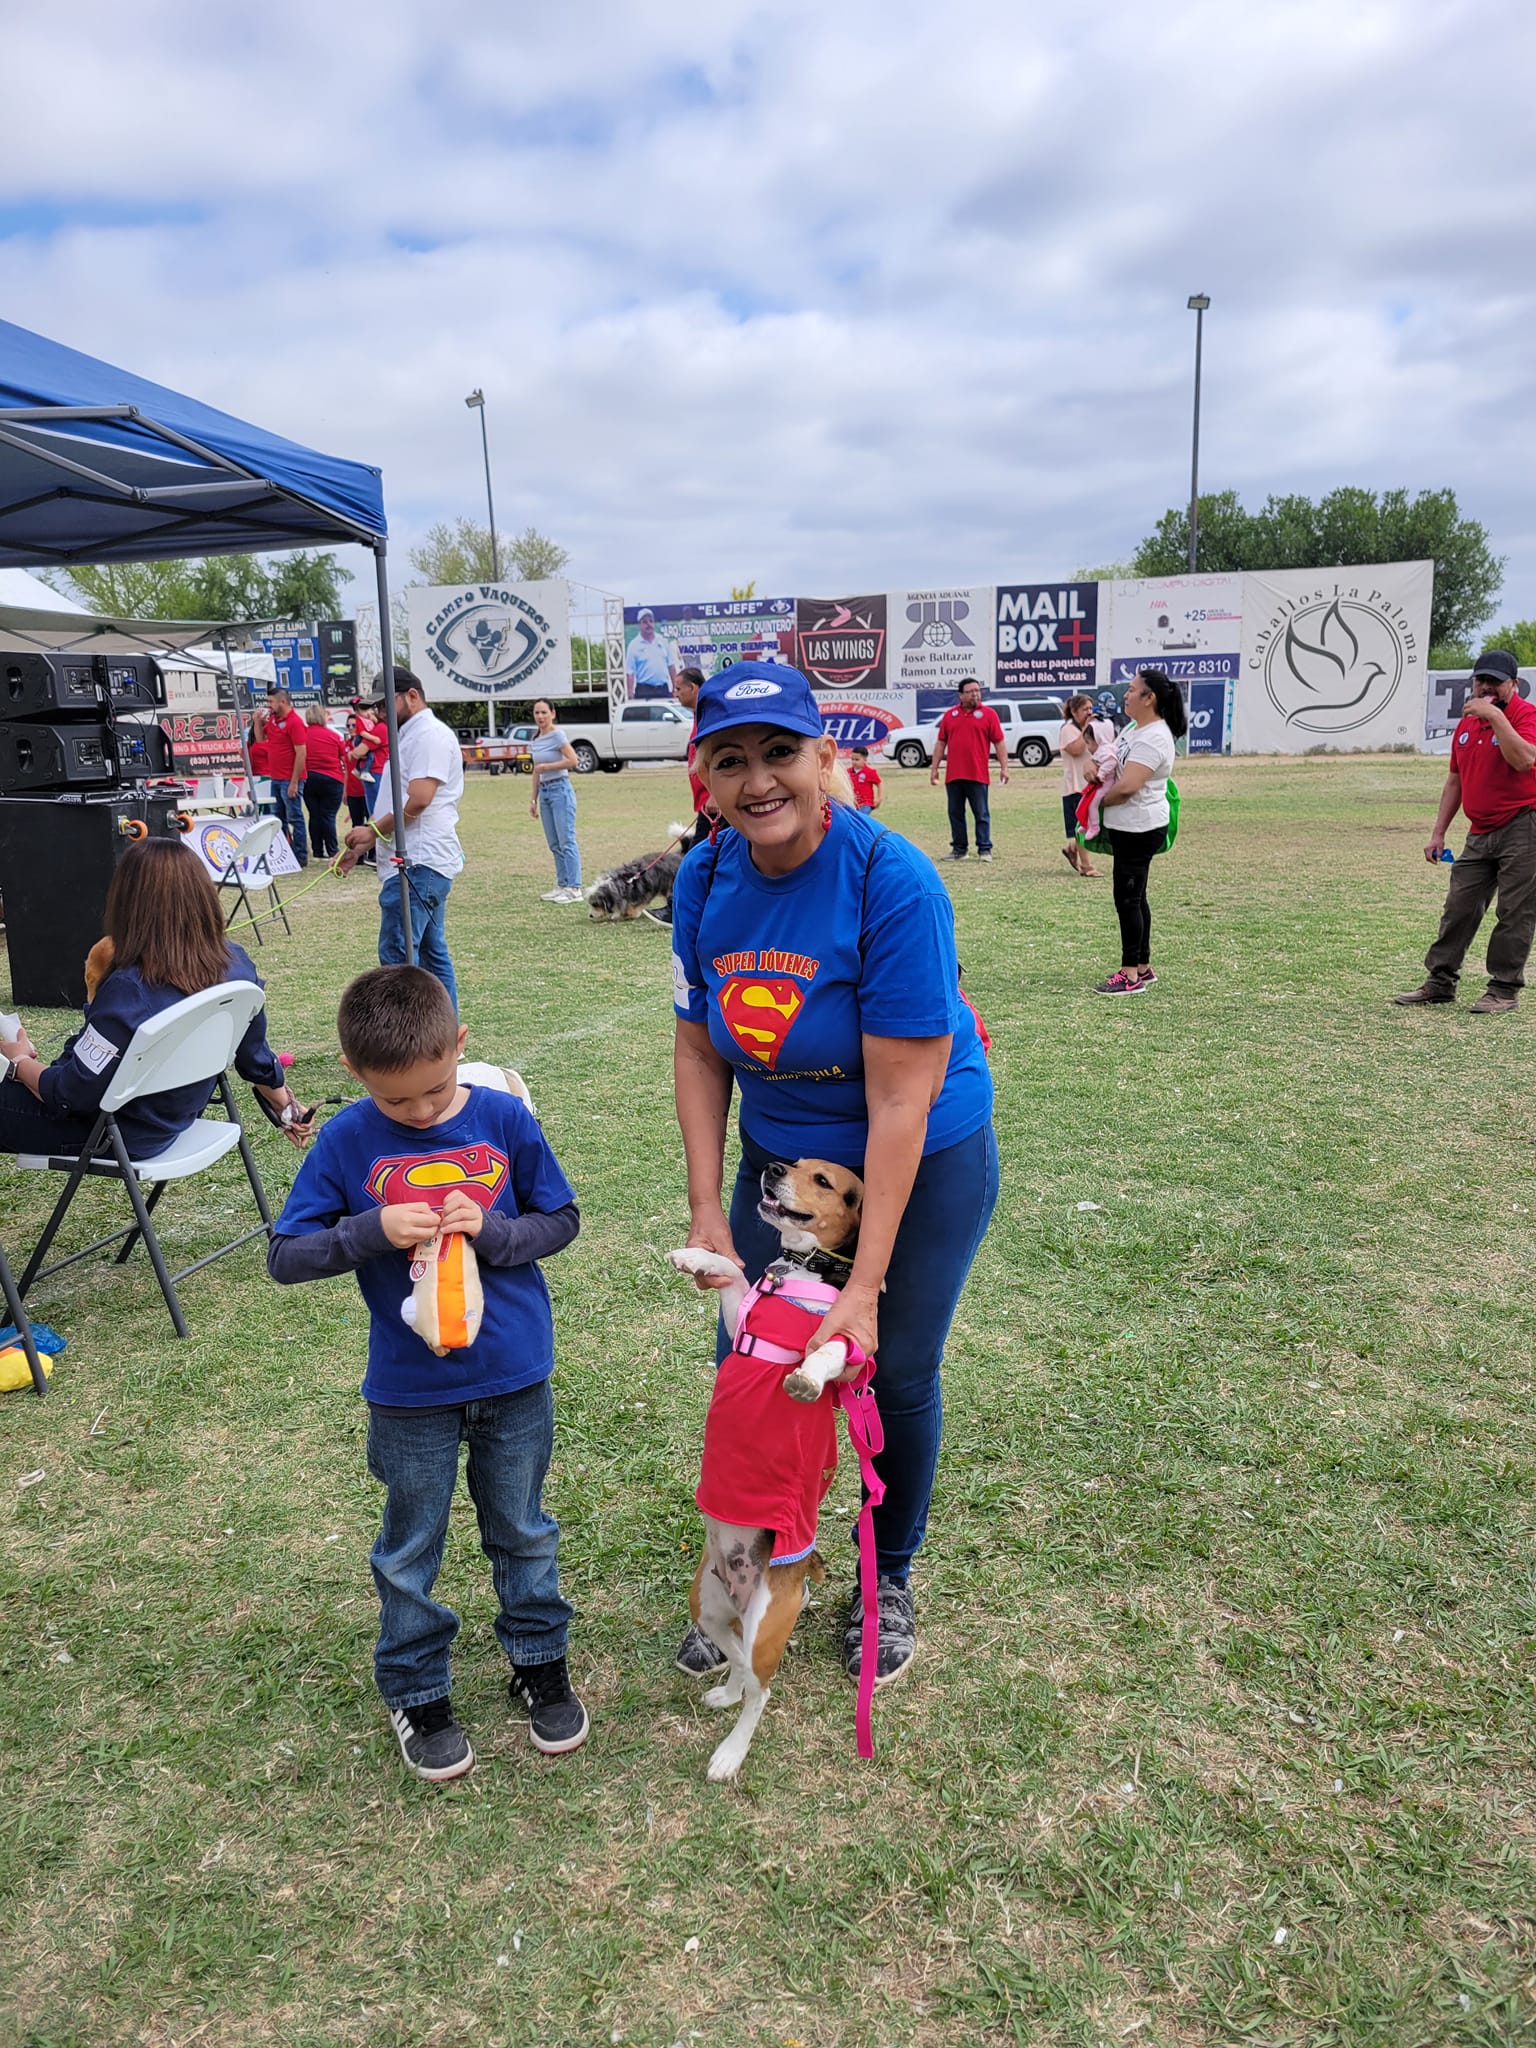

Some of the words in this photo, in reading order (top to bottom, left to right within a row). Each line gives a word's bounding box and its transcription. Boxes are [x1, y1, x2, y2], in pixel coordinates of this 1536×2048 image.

[906, 592, 937, 600] AGENCIA
[426, 592, 474, 636] CAMPO
[479, 587, 550, 633] VAQUEROS
[998, 590, 1086, 621] MAIL
[1184, 609, 1206, 621] +25
[1249, 589, 1323, 670] Caballos
[1334, 584, 1359, 598] La
[1368, 589, 1418, 665] Paloma
[678, 643, 718, 654] VAQUERO
[720, 642, 738, 652] POR
[740, 640, 779, 651] SIEMPRE
[808, 641, 830, 661] LAS
[832, 639, 875, 660] WINGS
[903, 654, 926, 663] Jose
[929, 651, 973, 662] Baltazar
[997, 659, 1029, 670] Recibe
[1031, 659, 1047, 669] tus
[1048, 658, 1095, 670] paquetes
[901, 667, 937, 677] Ramon
[940, 665, 976, 676] Lozoya
[1171, 662, 1195, 674] 772
[1198, 659, 1231, 674] 8310
[446, 669, 492, 693] FERMIN
[1004, 674, 1018, 683] en
[1019, 672, 1036, 682] Del
[1057, 671, 1087, 682] Texas
[735, 683, 770, 697] Ford
[846, 691, 904, 700] VAQUEROS
[852, 703, 893, 724] Health
[713, 950, 756, 978] SUPER
[758, 947, 820, 981] JÓVENES
